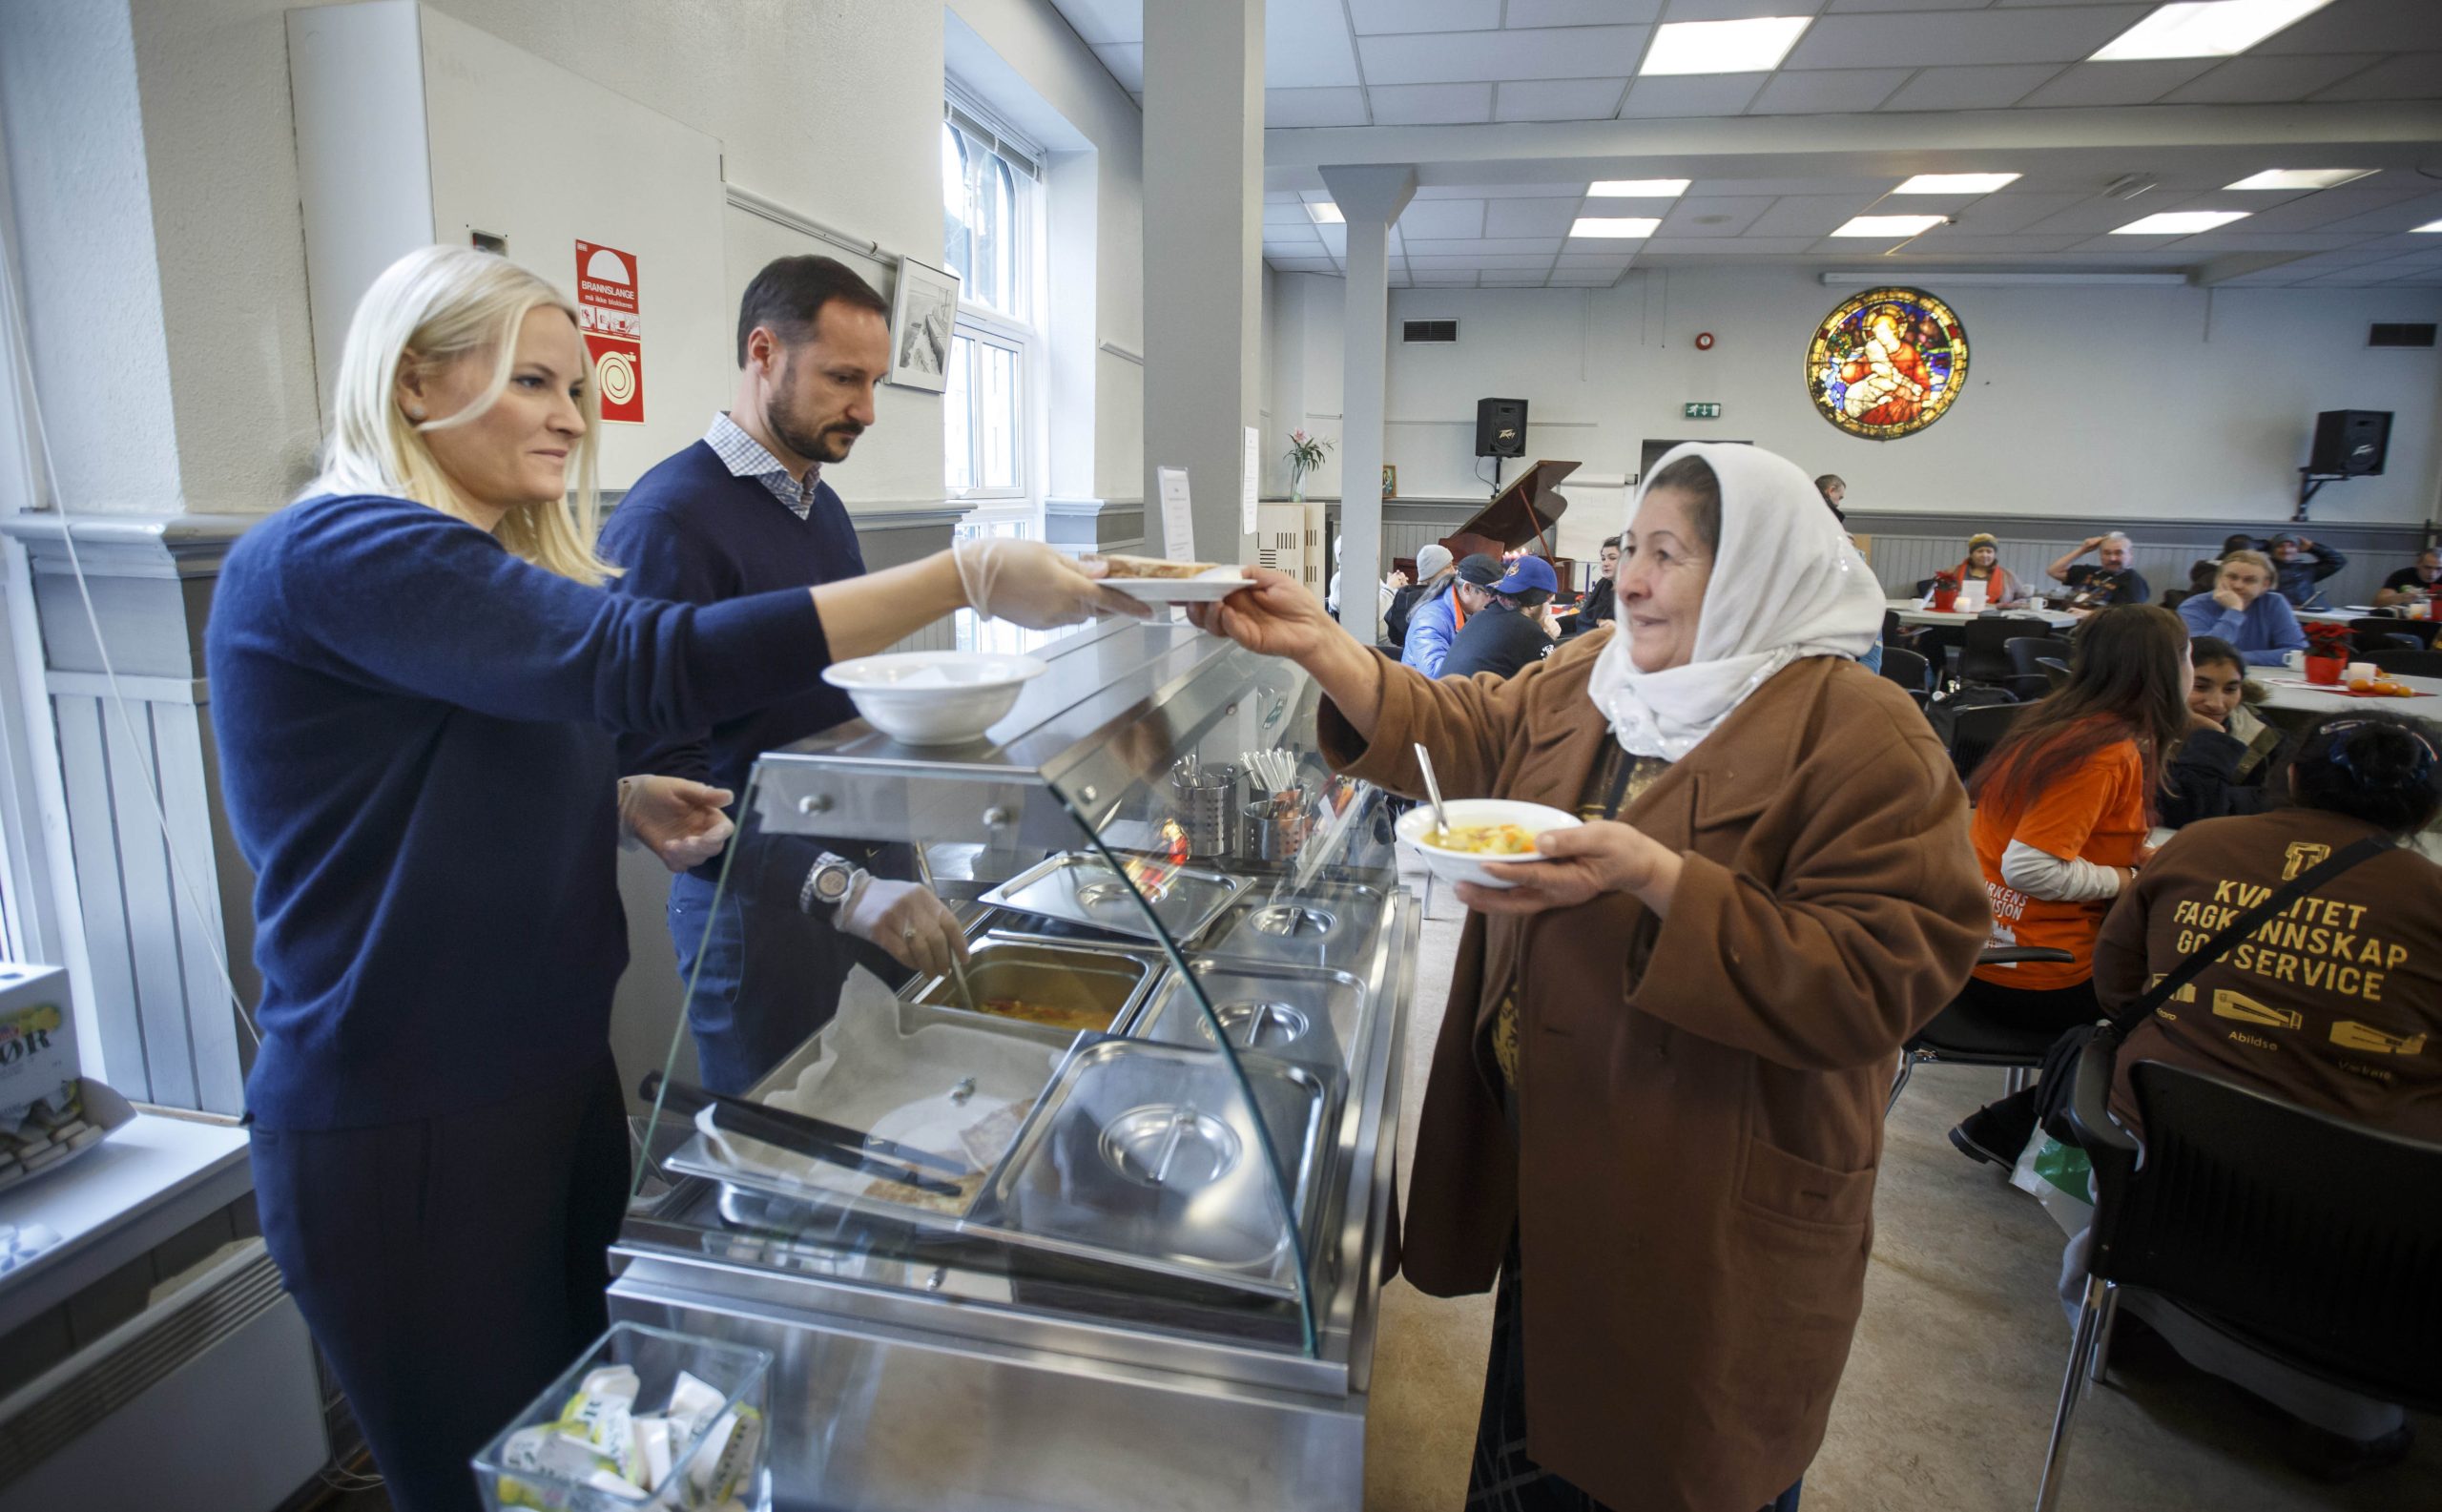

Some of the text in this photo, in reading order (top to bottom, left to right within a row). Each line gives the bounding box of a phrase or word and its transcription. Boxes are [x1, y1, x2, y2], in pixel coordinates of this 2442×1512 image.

[581, 280, 635, 300] BRANNSLANGE
[595, 296, 607, 304] ikke
[608, 298, 633, 308] blokkeres
[2214, 880, 2368, 931] KVAITET
[2173, 900, 2409, 970] FAGKNNSKAP
[2234, 943, 2385, 1001] SERVICE
